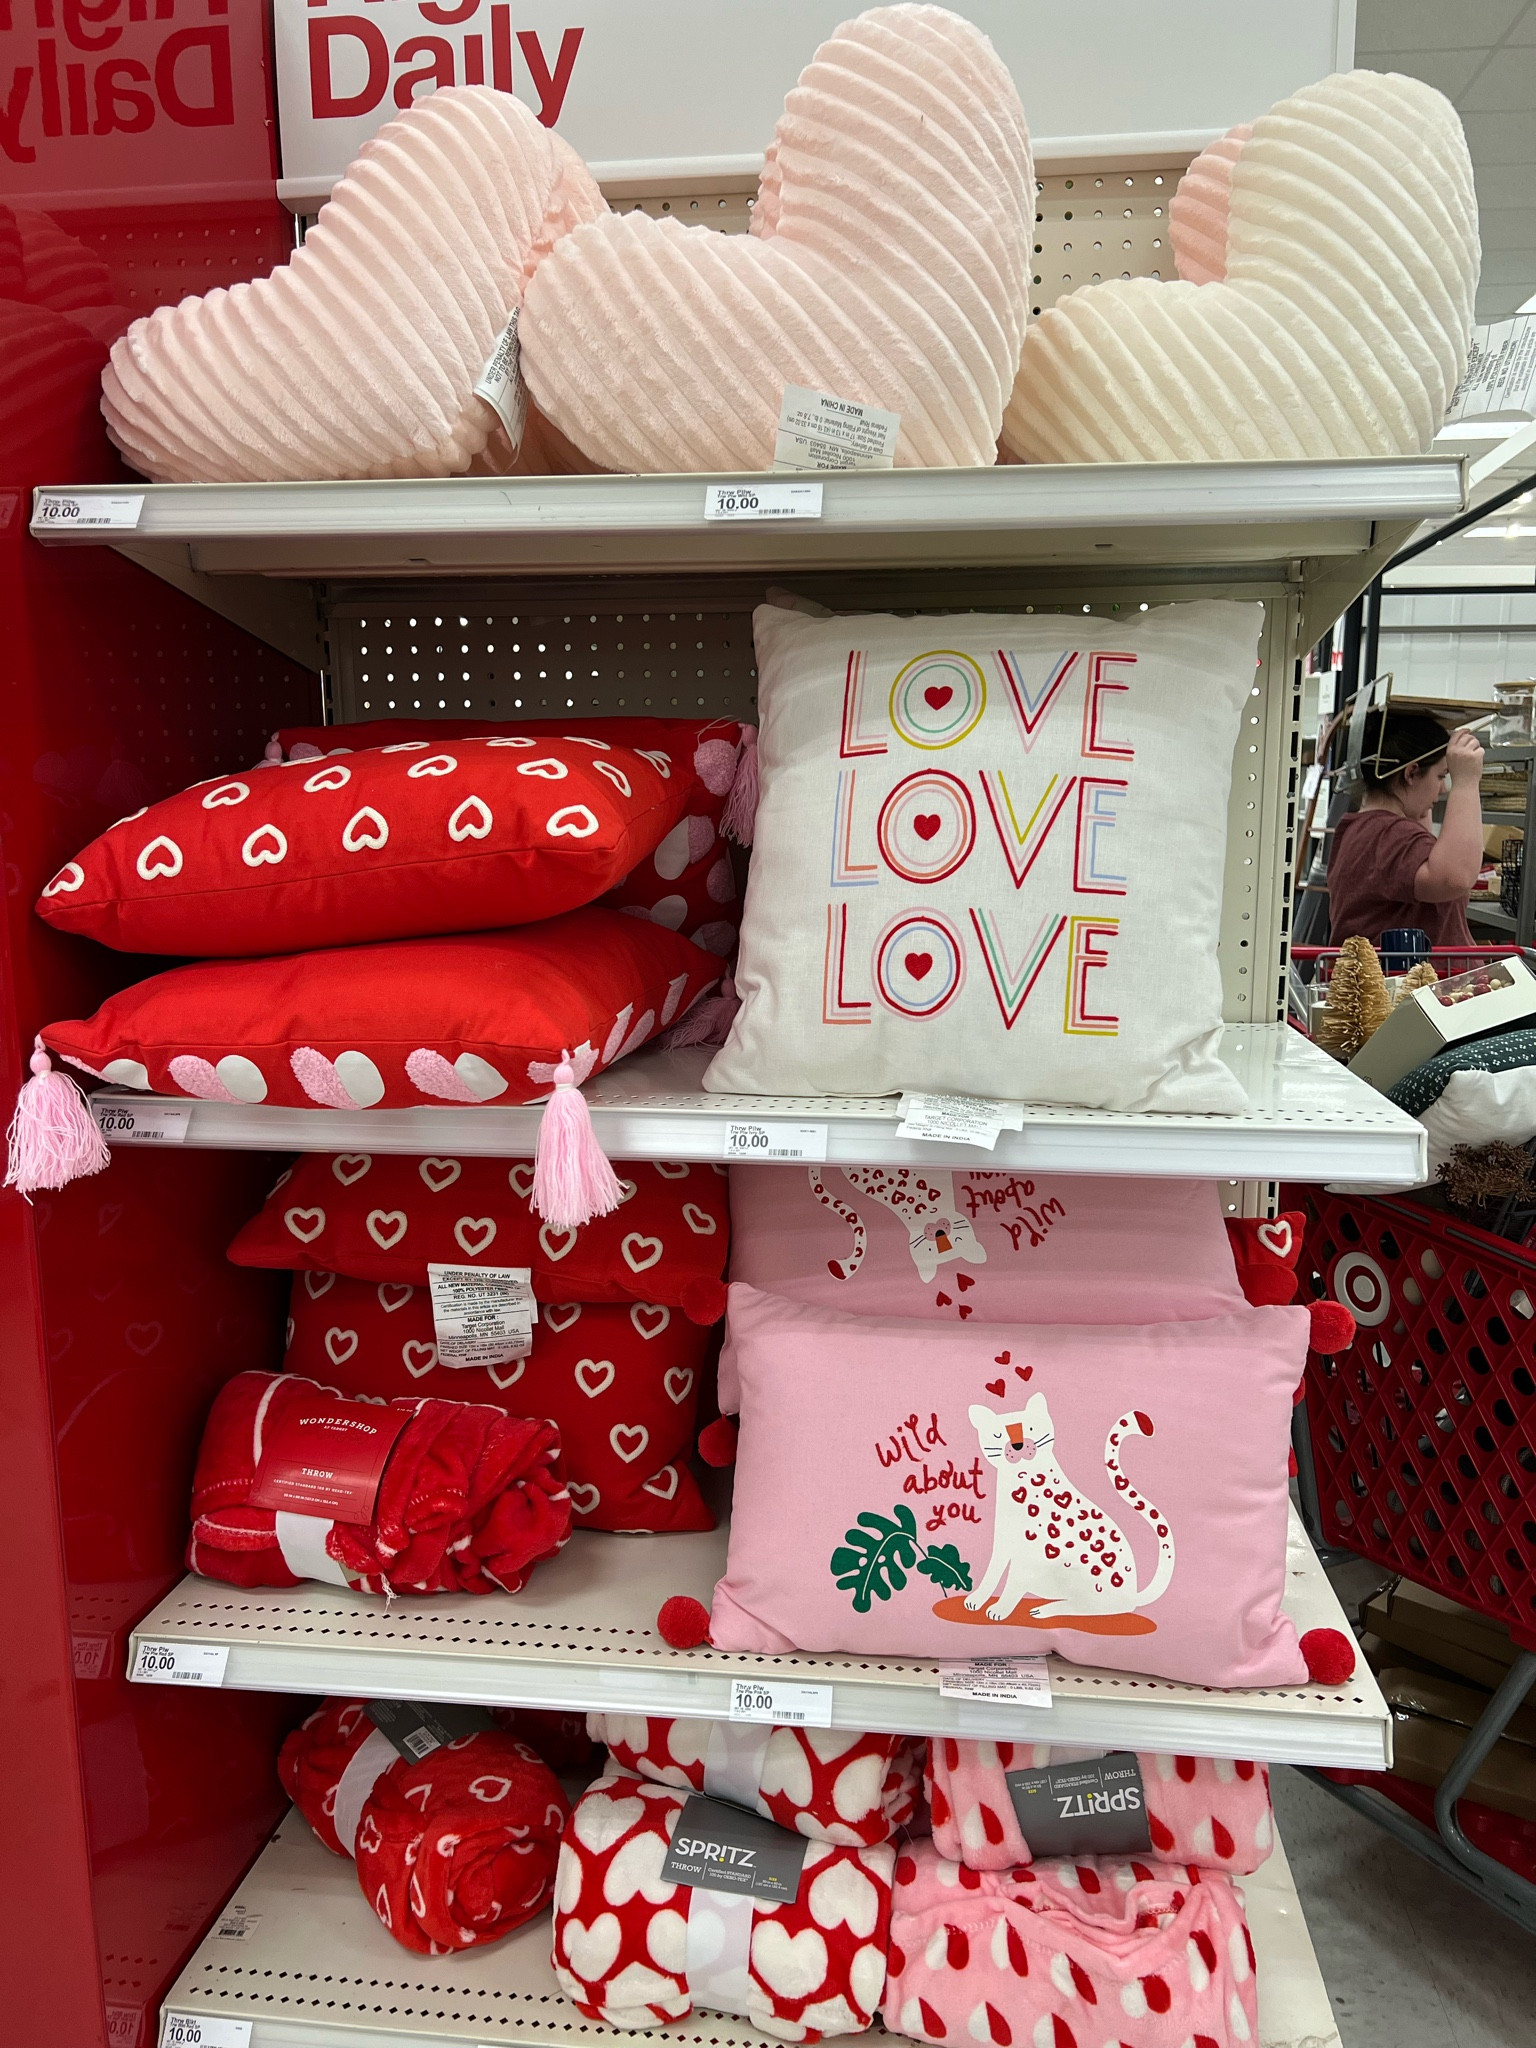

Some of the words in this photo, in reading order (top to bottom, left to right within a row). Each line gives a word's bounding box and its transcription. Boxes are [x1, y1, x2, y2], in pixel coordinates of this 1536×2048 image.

[308, 4, 584, 128] Daily
[819, 398, 838, 409] CHINA
[838, 403, 845, 411] IN
[845, 405, 863, 416] MADE
[794, 436, 807, 444] USA
[807, 451, 838, 464] Corporation
[717, 497, 758, 509] 10.00
[42, 507, 79, 517] 10.00
[840, 649, 1137, 761] LOVE
[830, 767, 1128, 895] LOVE
[822, 902, 1120, 1036] LOVE
[99, 1117, 134, 1129] 10.00
[730, 1135, 768, 1147] 10.00
[961, 1177, 1035, 1218] about
[1000, 1198, 1065, 1250] wild
[300, 1417, 377, 1435] WONDERSHOP
[875, 1413, 947, 1467] wild
[302, 1468, 333, 1478] THROW
[903, 1457, 986, 1499] about
[925, 1502, 981, 1531] you
[141, 1656, 175, 1669] 10.00
[736, 1694, 772, 1709] 10.00
[1104, 1769, 1136, 1780] THROW
[671, 1862, 702, 1872] THROW
[169, 2027, 201, 2043] 10.00
